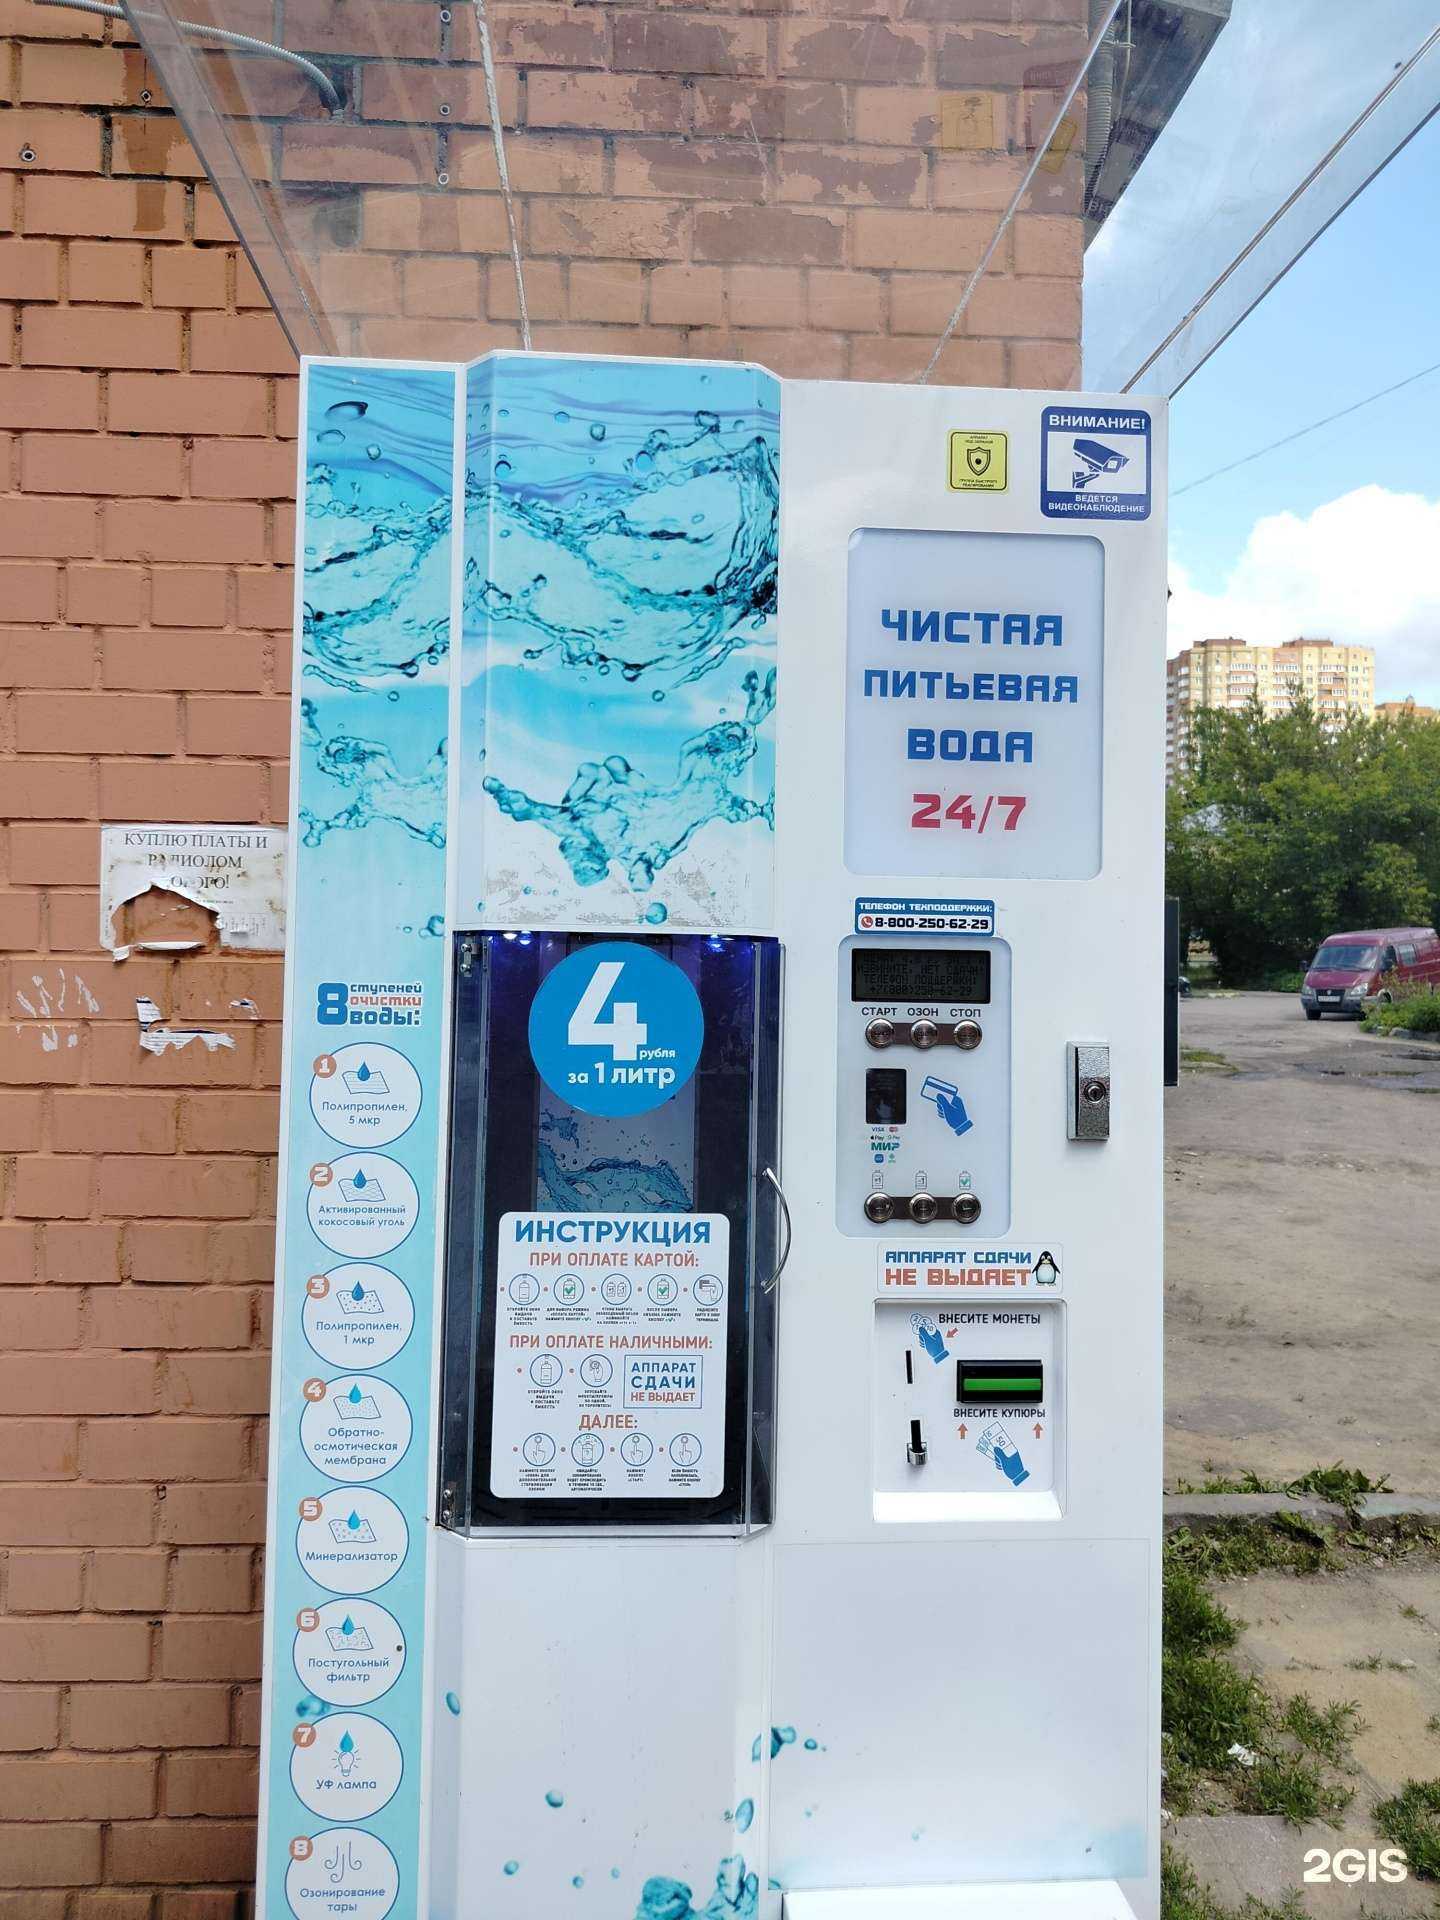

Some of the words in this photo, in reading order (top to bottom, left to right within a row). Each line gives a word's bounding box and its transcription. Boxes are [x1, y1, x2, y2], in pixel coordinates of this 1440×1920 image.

[1049, 414, 1145, 429] ВНИМАНИЕ!
[1048, 502, 1145, 513] ВИДЕОНАБЛЮДЕНИЕ
[881, 609, 1062, 646] ЧИСТАЯ
[864, 669, 1078, 703] ПИТЬЕВАЯ
[907, 728, 1032, 763] ВОДА
[911, 793, 1026, 834] 24/7
[125, 833, 187, 847] КУПЛЮ
[192, 834, 250, 848] ПЛАТЫ
[256, 836, 269, 849] И
[859, 902, 905, 911] ТЕЛЕФОН
[909, 903, 993, 913] ТЕХПОДДЕРЖКИ:
[875, 917, 989, 930] 8-800-250-62-29
[317, 983, 349, 1025] 8
[350, 983, 422, 994] ступеней
[350, 996, 422, 1006] очистки
[350, 1007, 420, 1025] воды:
[568, 962, 647, 1061] 4
[639, 1048, 676, 1060] рубля
[861, 1007, 898, 1016] СТАРТ
[907, 1008, 939, 1016] ОЗОН
[950, 1008, 982, 1017] СТОП
[319, 1058, 330, 1073] 1
[568, 1072, 588, 1084] за
[594, 1062, 605, 1084] 1
[611, 1067, 676, 1089] литр
[322, 1101, 408, 1113] Полипропилен,
[349, 1116, 355, 1125] 5
[358, 1117, 381, 1127] мкр
[871, 1142, 901, 1151] МИР
[313, 1166, 328, 1182] 2
[318, 1205, 406, 1215] Активированный
[318, 1217, 375, 1227] кокосовый
[378, 1218, 405, 1228] уголь
[515, 1220, 711, 1247] ИНСТРУКЦИЯ
[530, 1252, 561, 1266] ПРИ
[567, 1252, 629, 1267] ОПЛАТЕ
[634, 1250, 699, 1267] КАРТОЙ:
[885, 1251, 966, 1264] АППАРАТ
[973, 1252, 1032, 1264] СДАЧИ
[885, 1268, 917, 1286] НЕ
[927, 1268, 1032, 1286] ВЫДАЕТ
[311, 1278, 325, 1294] 3
[938, 1313, 989, 1324] ВНЕСИТЕ
[992, 1314, 1041, 1324] МОНЕТЫ
[316, 1321, 402, 1332] Полипропилен,
[343, 1335, 348, 1345] 1
[352, 1336, 375, 1346] мкр
[510, 1335, 540, 1349] ПРИ
[546, 1335, 604, 1349] ОПЛАТЕ
[609, 1335, 712, 1349] НАЛИЧНЫМИ:
[631, 1362, 696, 1373] АППАРАТ
[307, 1381, 322, 1397] 4
[631, 1375, 696, 1390] СДАЧИ
[630, 1392, 646, 1402] НЕ
[649, 1392, 696, 1403] ВЫДАЕТ
[953, 1408, 998, 1418] ВНЕСИТЕ
[1001, 1408, 1046, 1418] КУПЮРЫ
[579, 1414, 638, 1431] ДАЛЕЕ:
[328, 1427, 384, 1438] Обратно-
[314, 1442, 398, 1451] осмотическая
[324, 1455, 387, 1466] мембрана
[303, 1501, 318, 1517] 5
[305, 1551, 398, 1563] Минерализатор
[300, 1612, 315, 1628] 6
[308, 1657, 390, 1669] Постугольный
[326, 1671, 370, 1683] фильтр
[297, 1727, 312, 1743] 7
[316, 1779, 334, 1790] УФ
[337, 1780, 377, 1791] лампа
[294, 1840, 309, 1856] 8
[300, 1888, 385, 1899] Озонирование
[327, 1903, 358, 1913] тары
